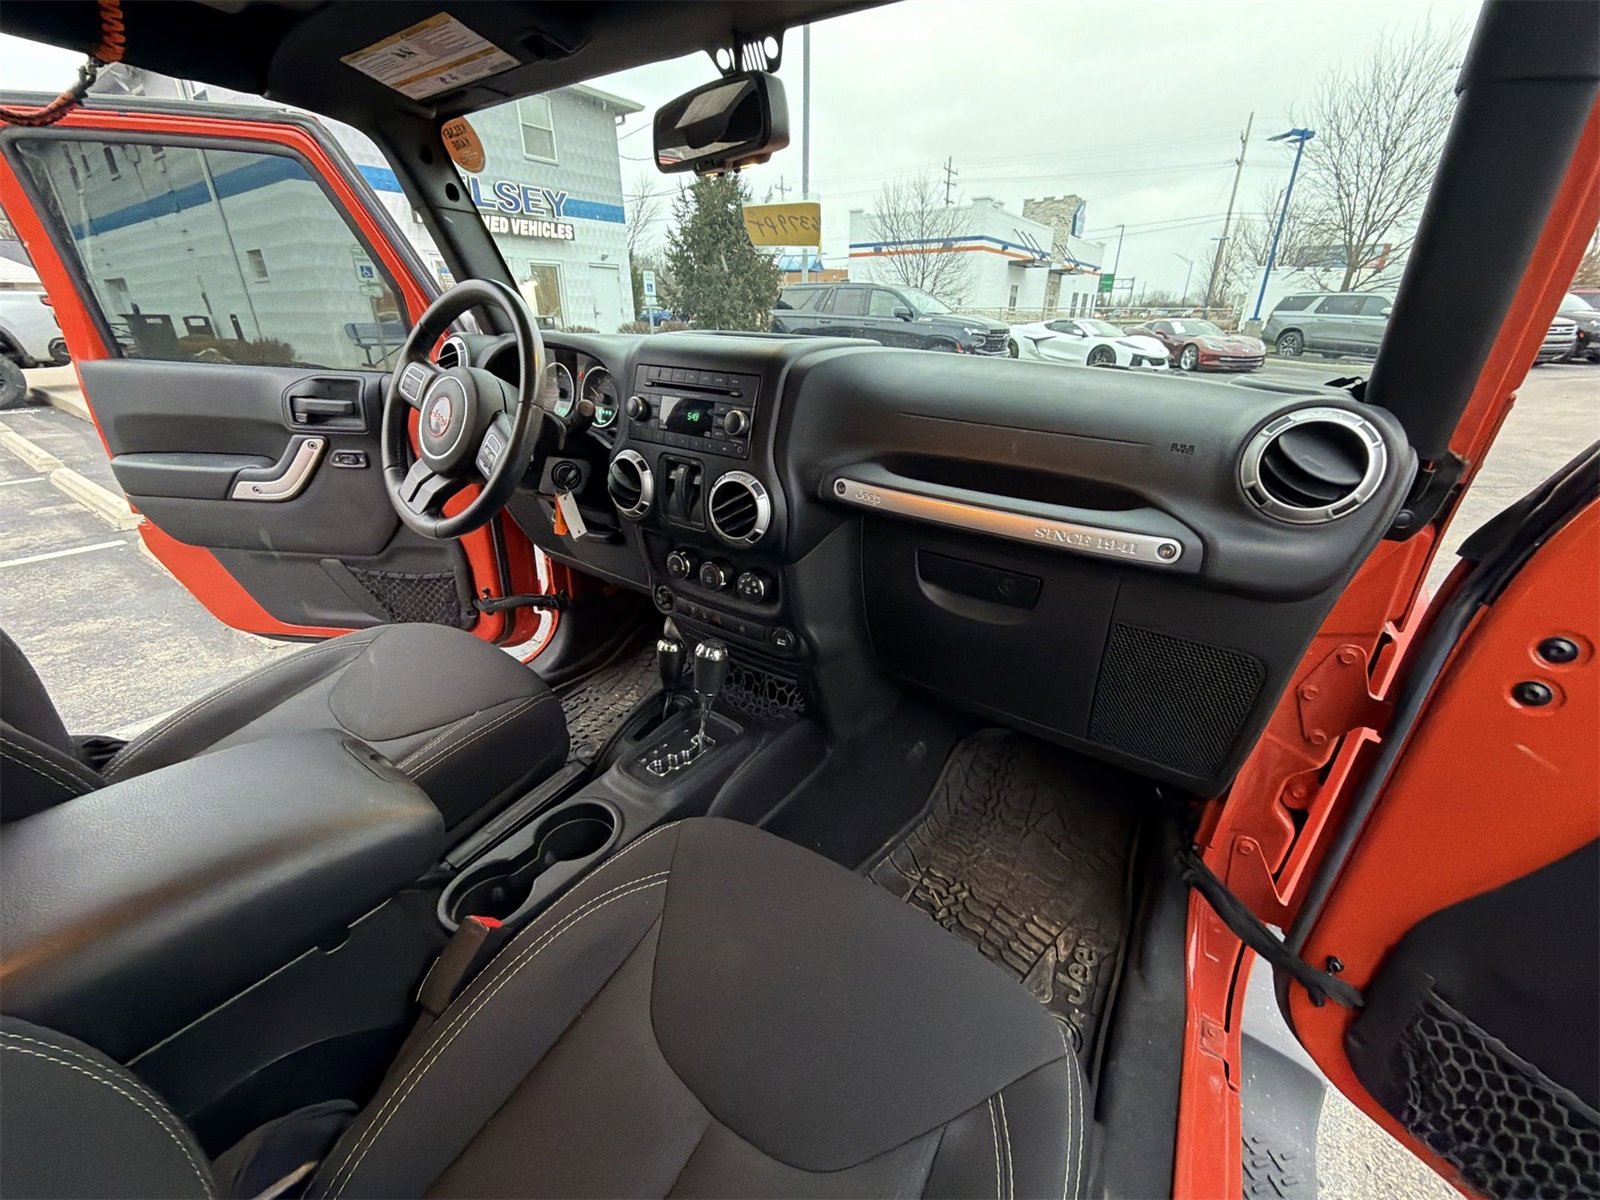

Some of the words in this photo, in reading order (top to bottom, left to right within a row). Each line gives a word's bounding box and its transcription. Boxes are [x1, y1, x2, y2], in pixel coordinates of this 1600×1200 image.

[460, 174, 569, 218] LSEY
[481, 214, 509, 234] NED
[511, 218, 575, 240] VEHICLES
[855, 488, 881, 505] Jeep
[1034, 526, 1093, 548] SINCE
[1097, 537, 1138, 555] 1941
